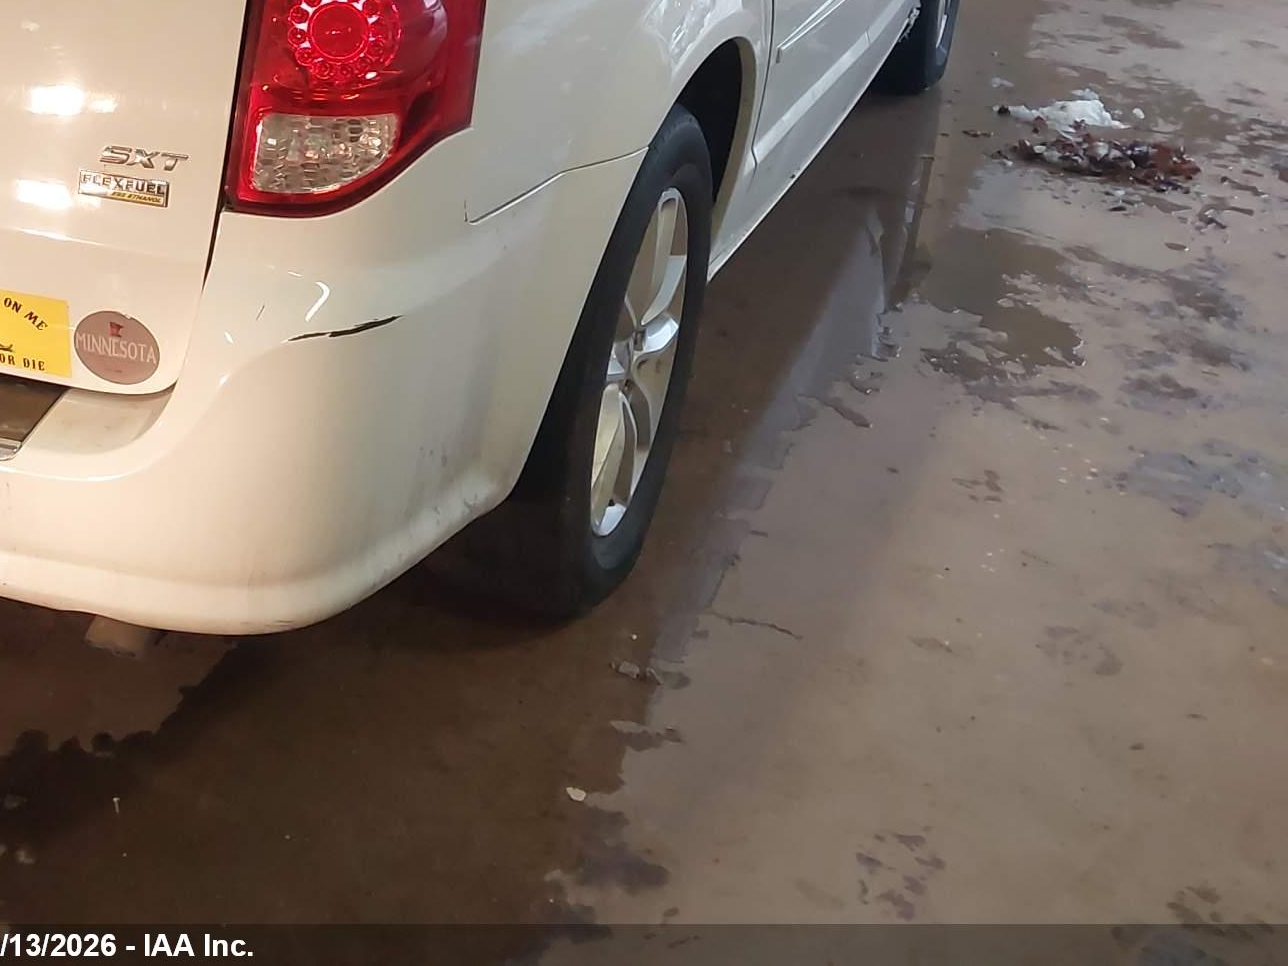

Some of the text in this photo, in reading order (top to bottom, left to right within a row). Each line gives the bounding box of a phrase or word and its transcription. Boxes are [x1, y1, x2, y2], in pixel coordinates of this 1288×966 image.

[99, 145, 189, 171] SXT
[3, 297, 22, 313] ON
[24, 311, 48, 331] ME
[0, 353, 16, 366] OR
[23, 358, 45, 371] DIE
[75, 332, 157, 364] MINNESOTA
